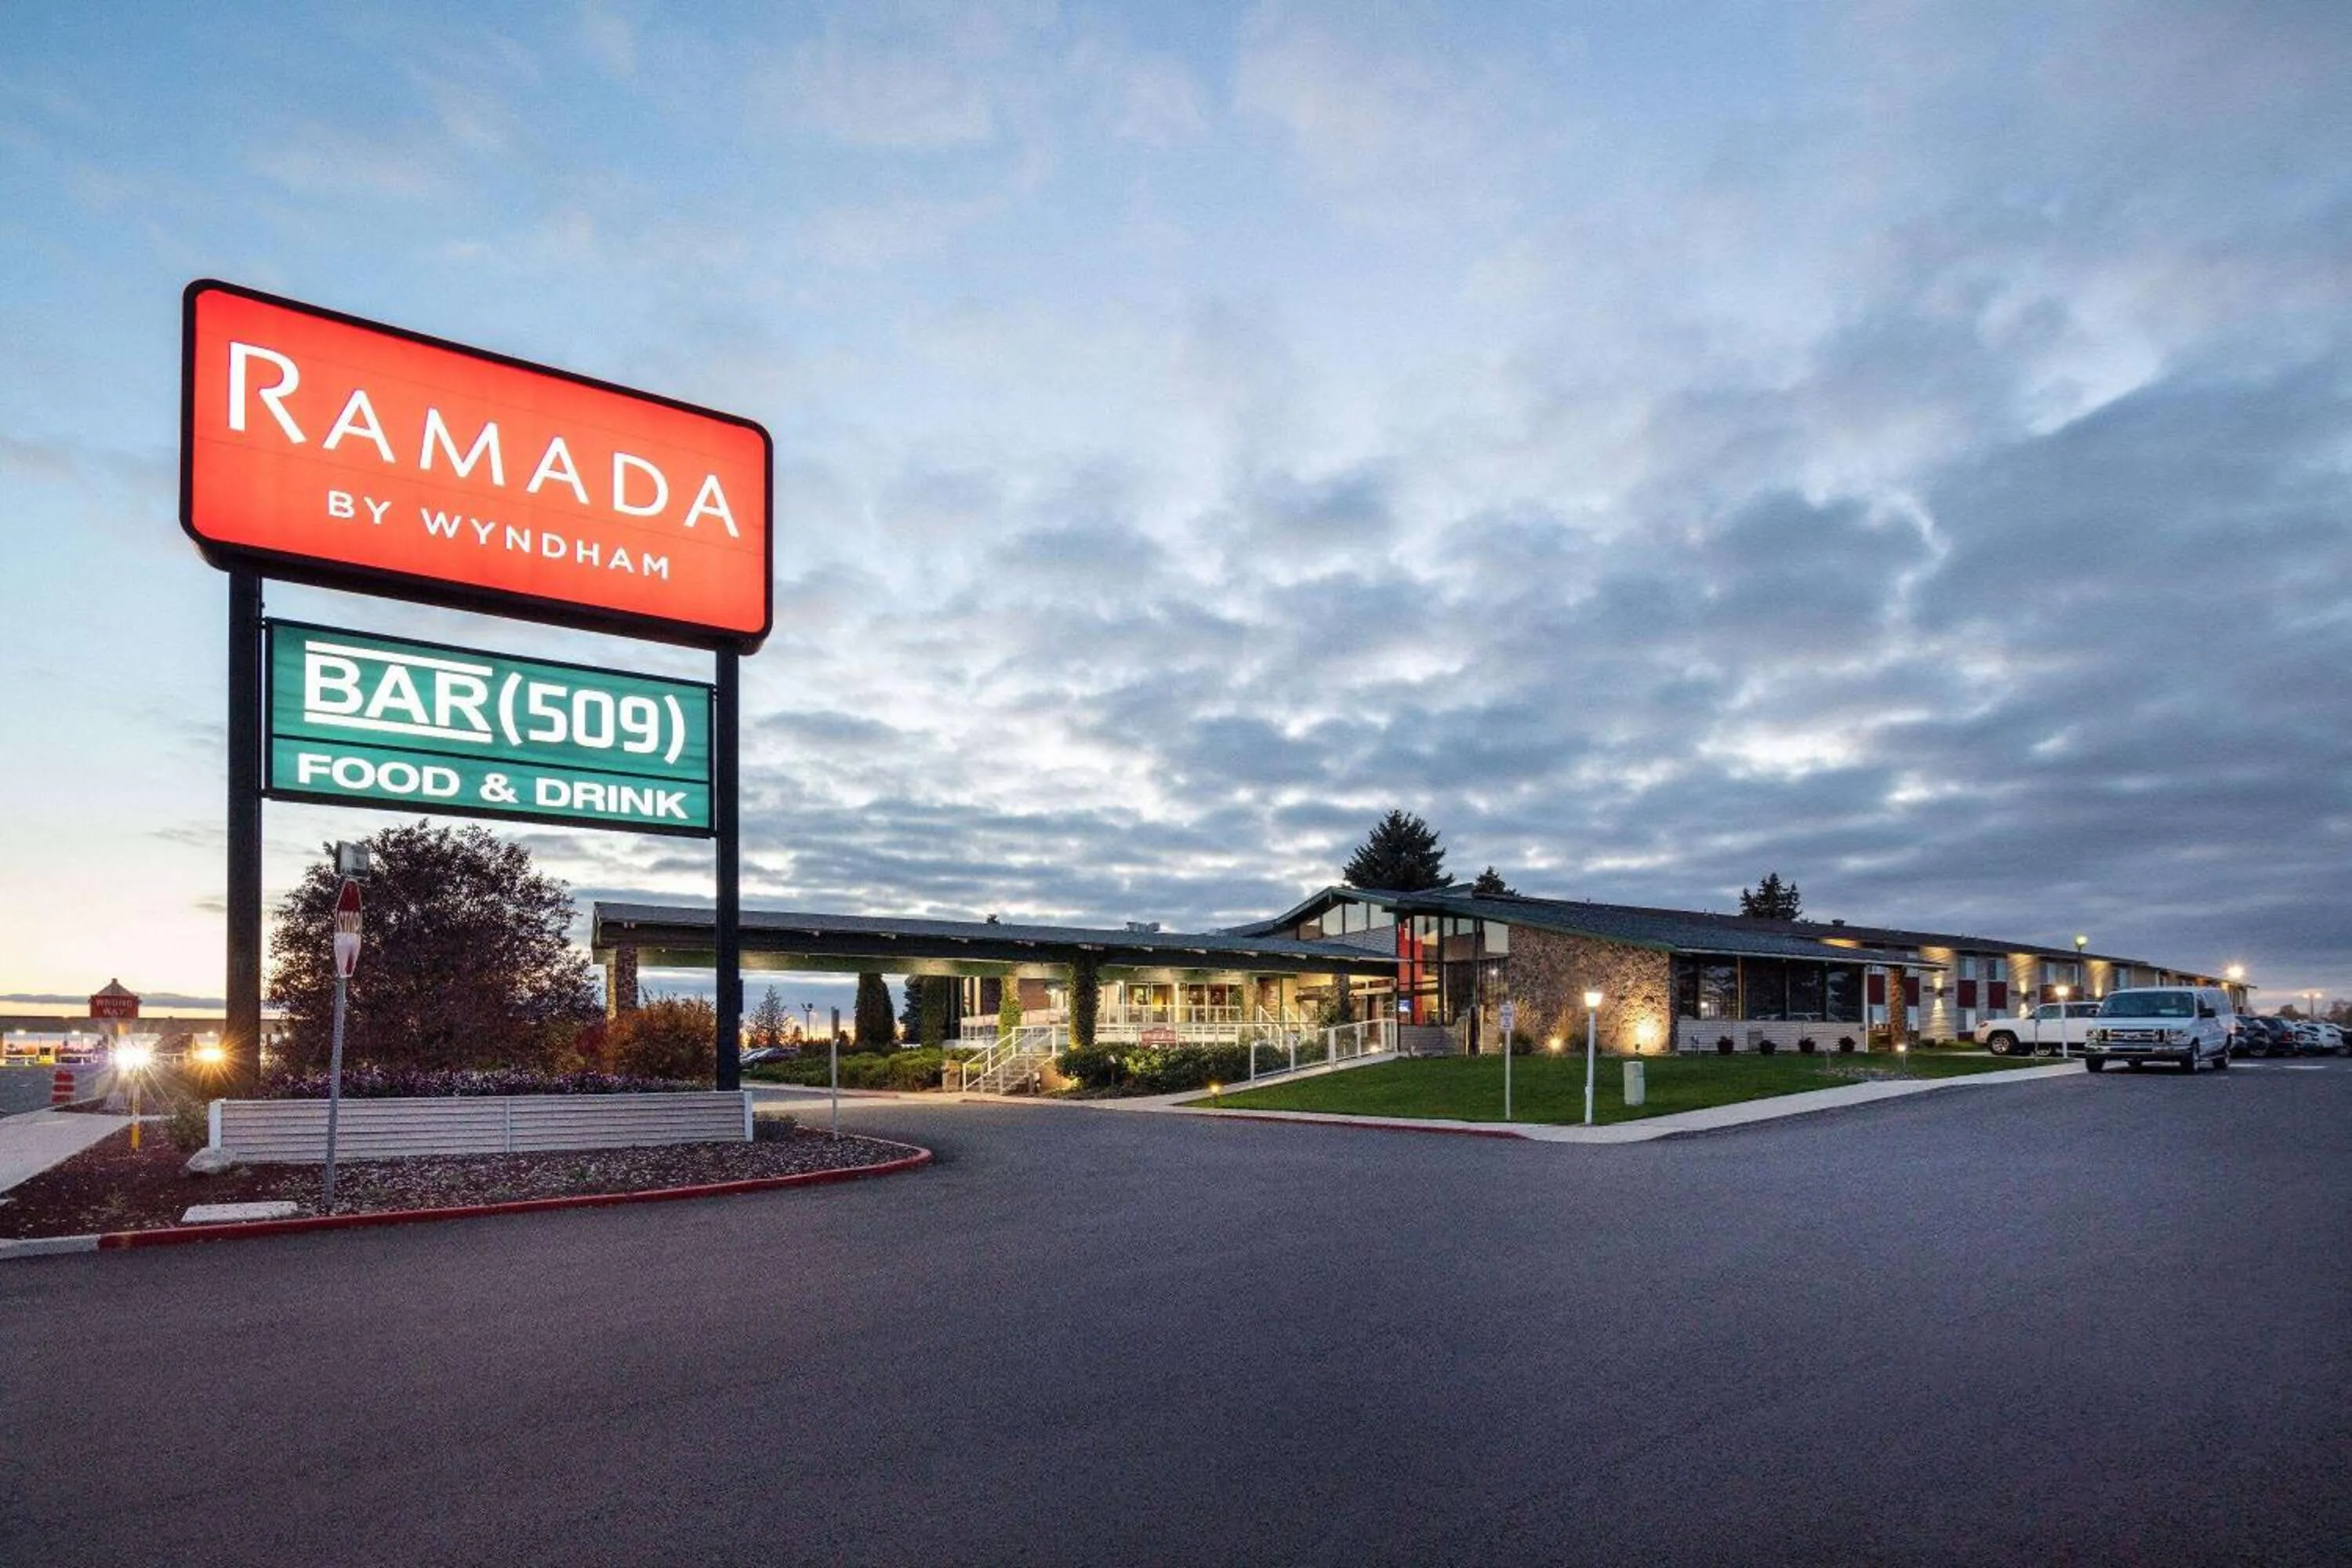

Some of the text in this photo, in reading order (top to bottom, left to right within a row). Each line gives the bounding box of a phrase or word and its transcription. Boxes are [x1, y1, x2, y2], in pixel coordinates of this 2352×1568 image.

[228, 341, 740, 539] RAMADA
[327, 489, 670, 580] BY WYNDHAM
[297, 752, 688, 820] FOOD & DRINK
[338, 910, 361, 934] STOP
[103, 1007, 125, 1017] WAY
